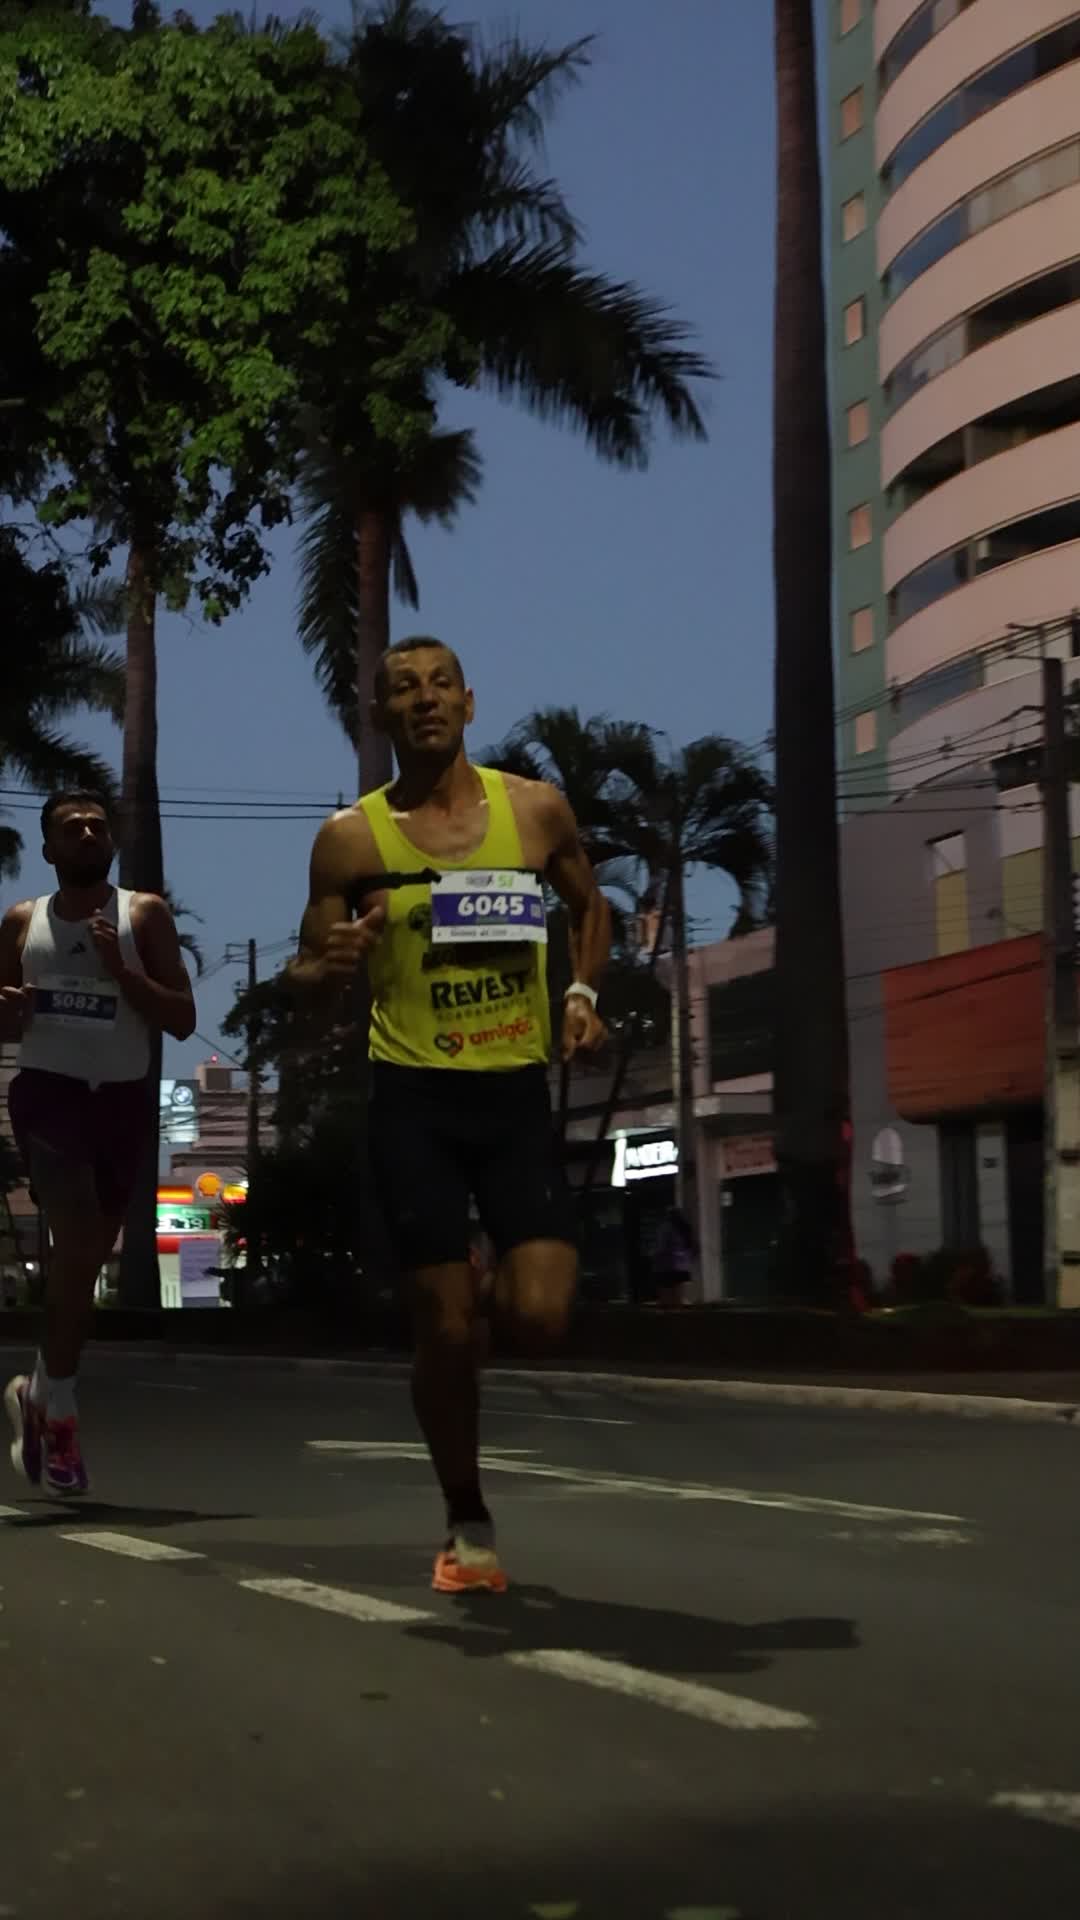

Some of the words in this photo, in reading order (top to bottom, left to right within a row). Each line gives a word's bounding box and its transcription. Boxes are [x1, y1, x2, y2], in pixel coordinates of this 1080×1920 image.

[458, 895, 525, 917] 6045
[51, 992, 99, 1010] 5082
[431, 971, 528, 1009] REVEST
